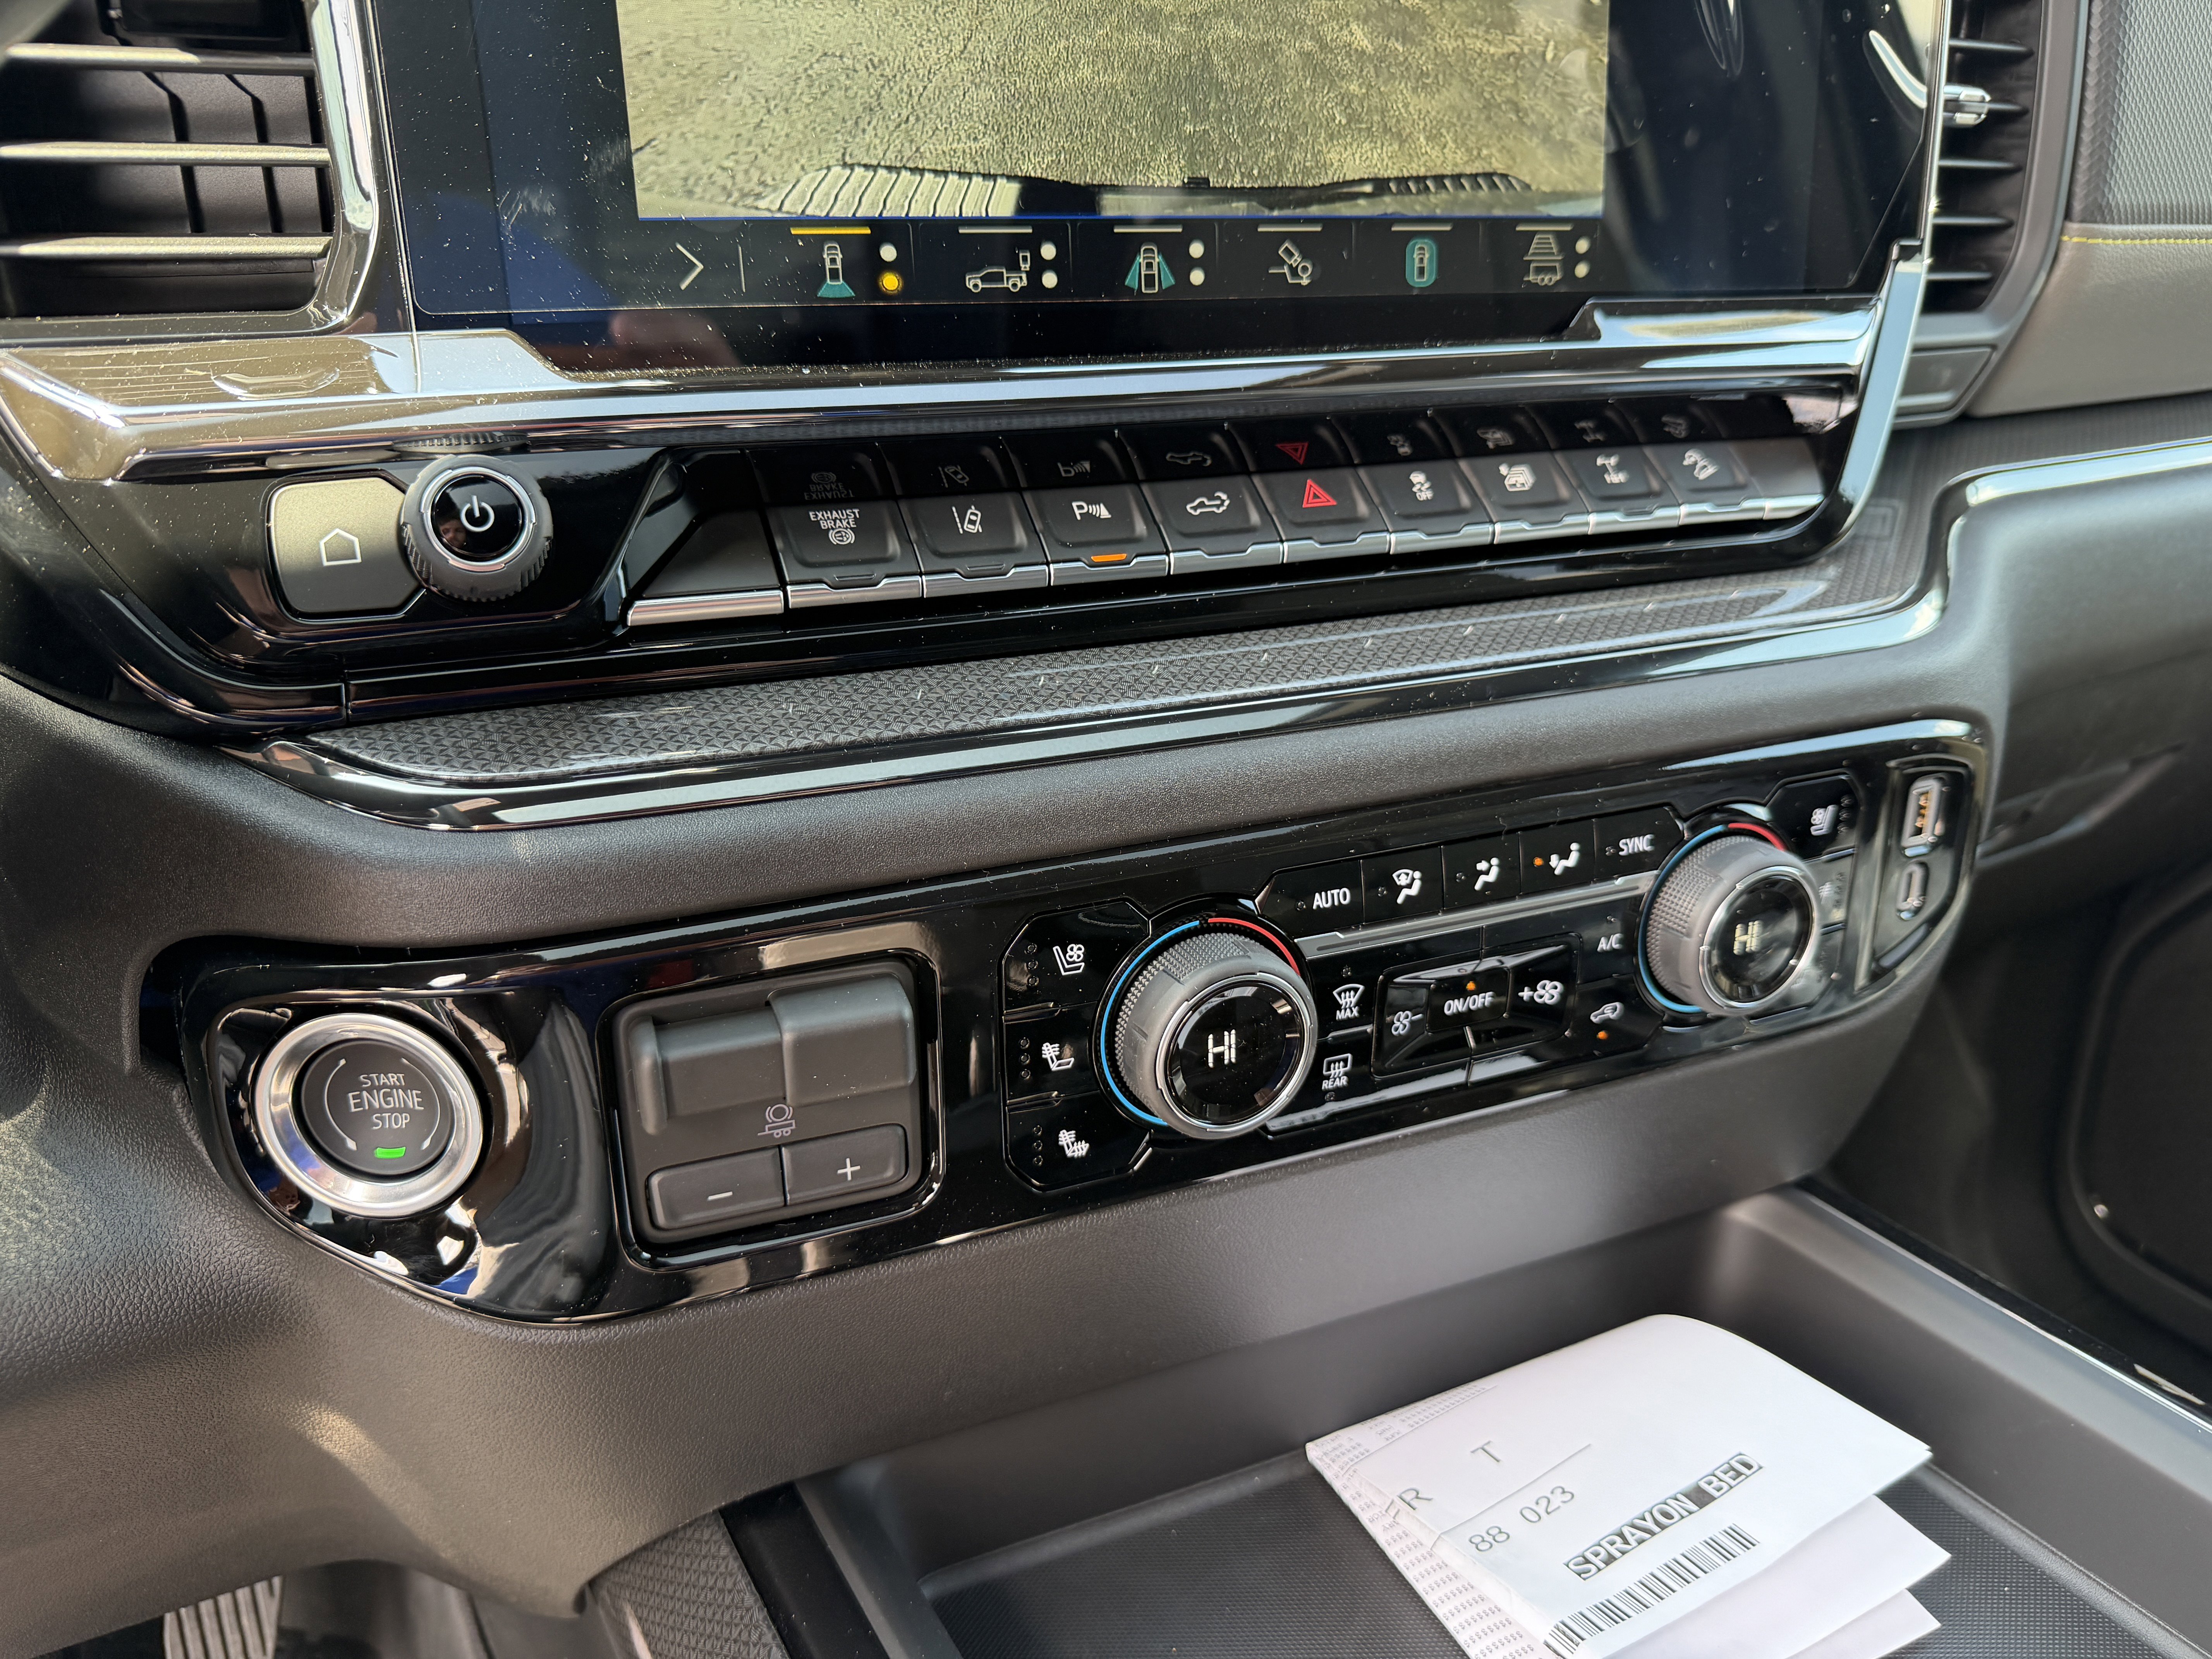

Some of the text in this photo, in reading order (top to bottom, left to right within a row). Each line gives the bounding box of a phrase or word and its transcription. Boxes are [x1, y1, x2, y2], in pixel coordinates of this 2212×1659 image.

[1416, 489, 1434, 501] OFF
[809, 508, 860, 521] EXHAUST
[819, 519, 857, 529] BRAKE
[1618, 834, 1655, 855] SYNC
[1312, 888, 1351, 910] AUTO
[1597, 934, 1623, 952] A/C
[1733, 920, 1762, 955] HI
[1336, 1006, 1359, 1020] MAX
[1444, 992, 1495, 1016] ON/OFF
[1207, 1029, 1237, 1068] HI
[360, 1073, 405, 1087] START
[1321, 1076, 1348, 1090] REAR
[348, 1089, 424, 1112] ENGINE
[373, 1113, 410, 1129] STOP
[1470, 1440, 1501, 1463] T
[1468, 1486, 1574, 1552] 88 023
[1568, 1454, 1759, 1579] SPRAYON BED
